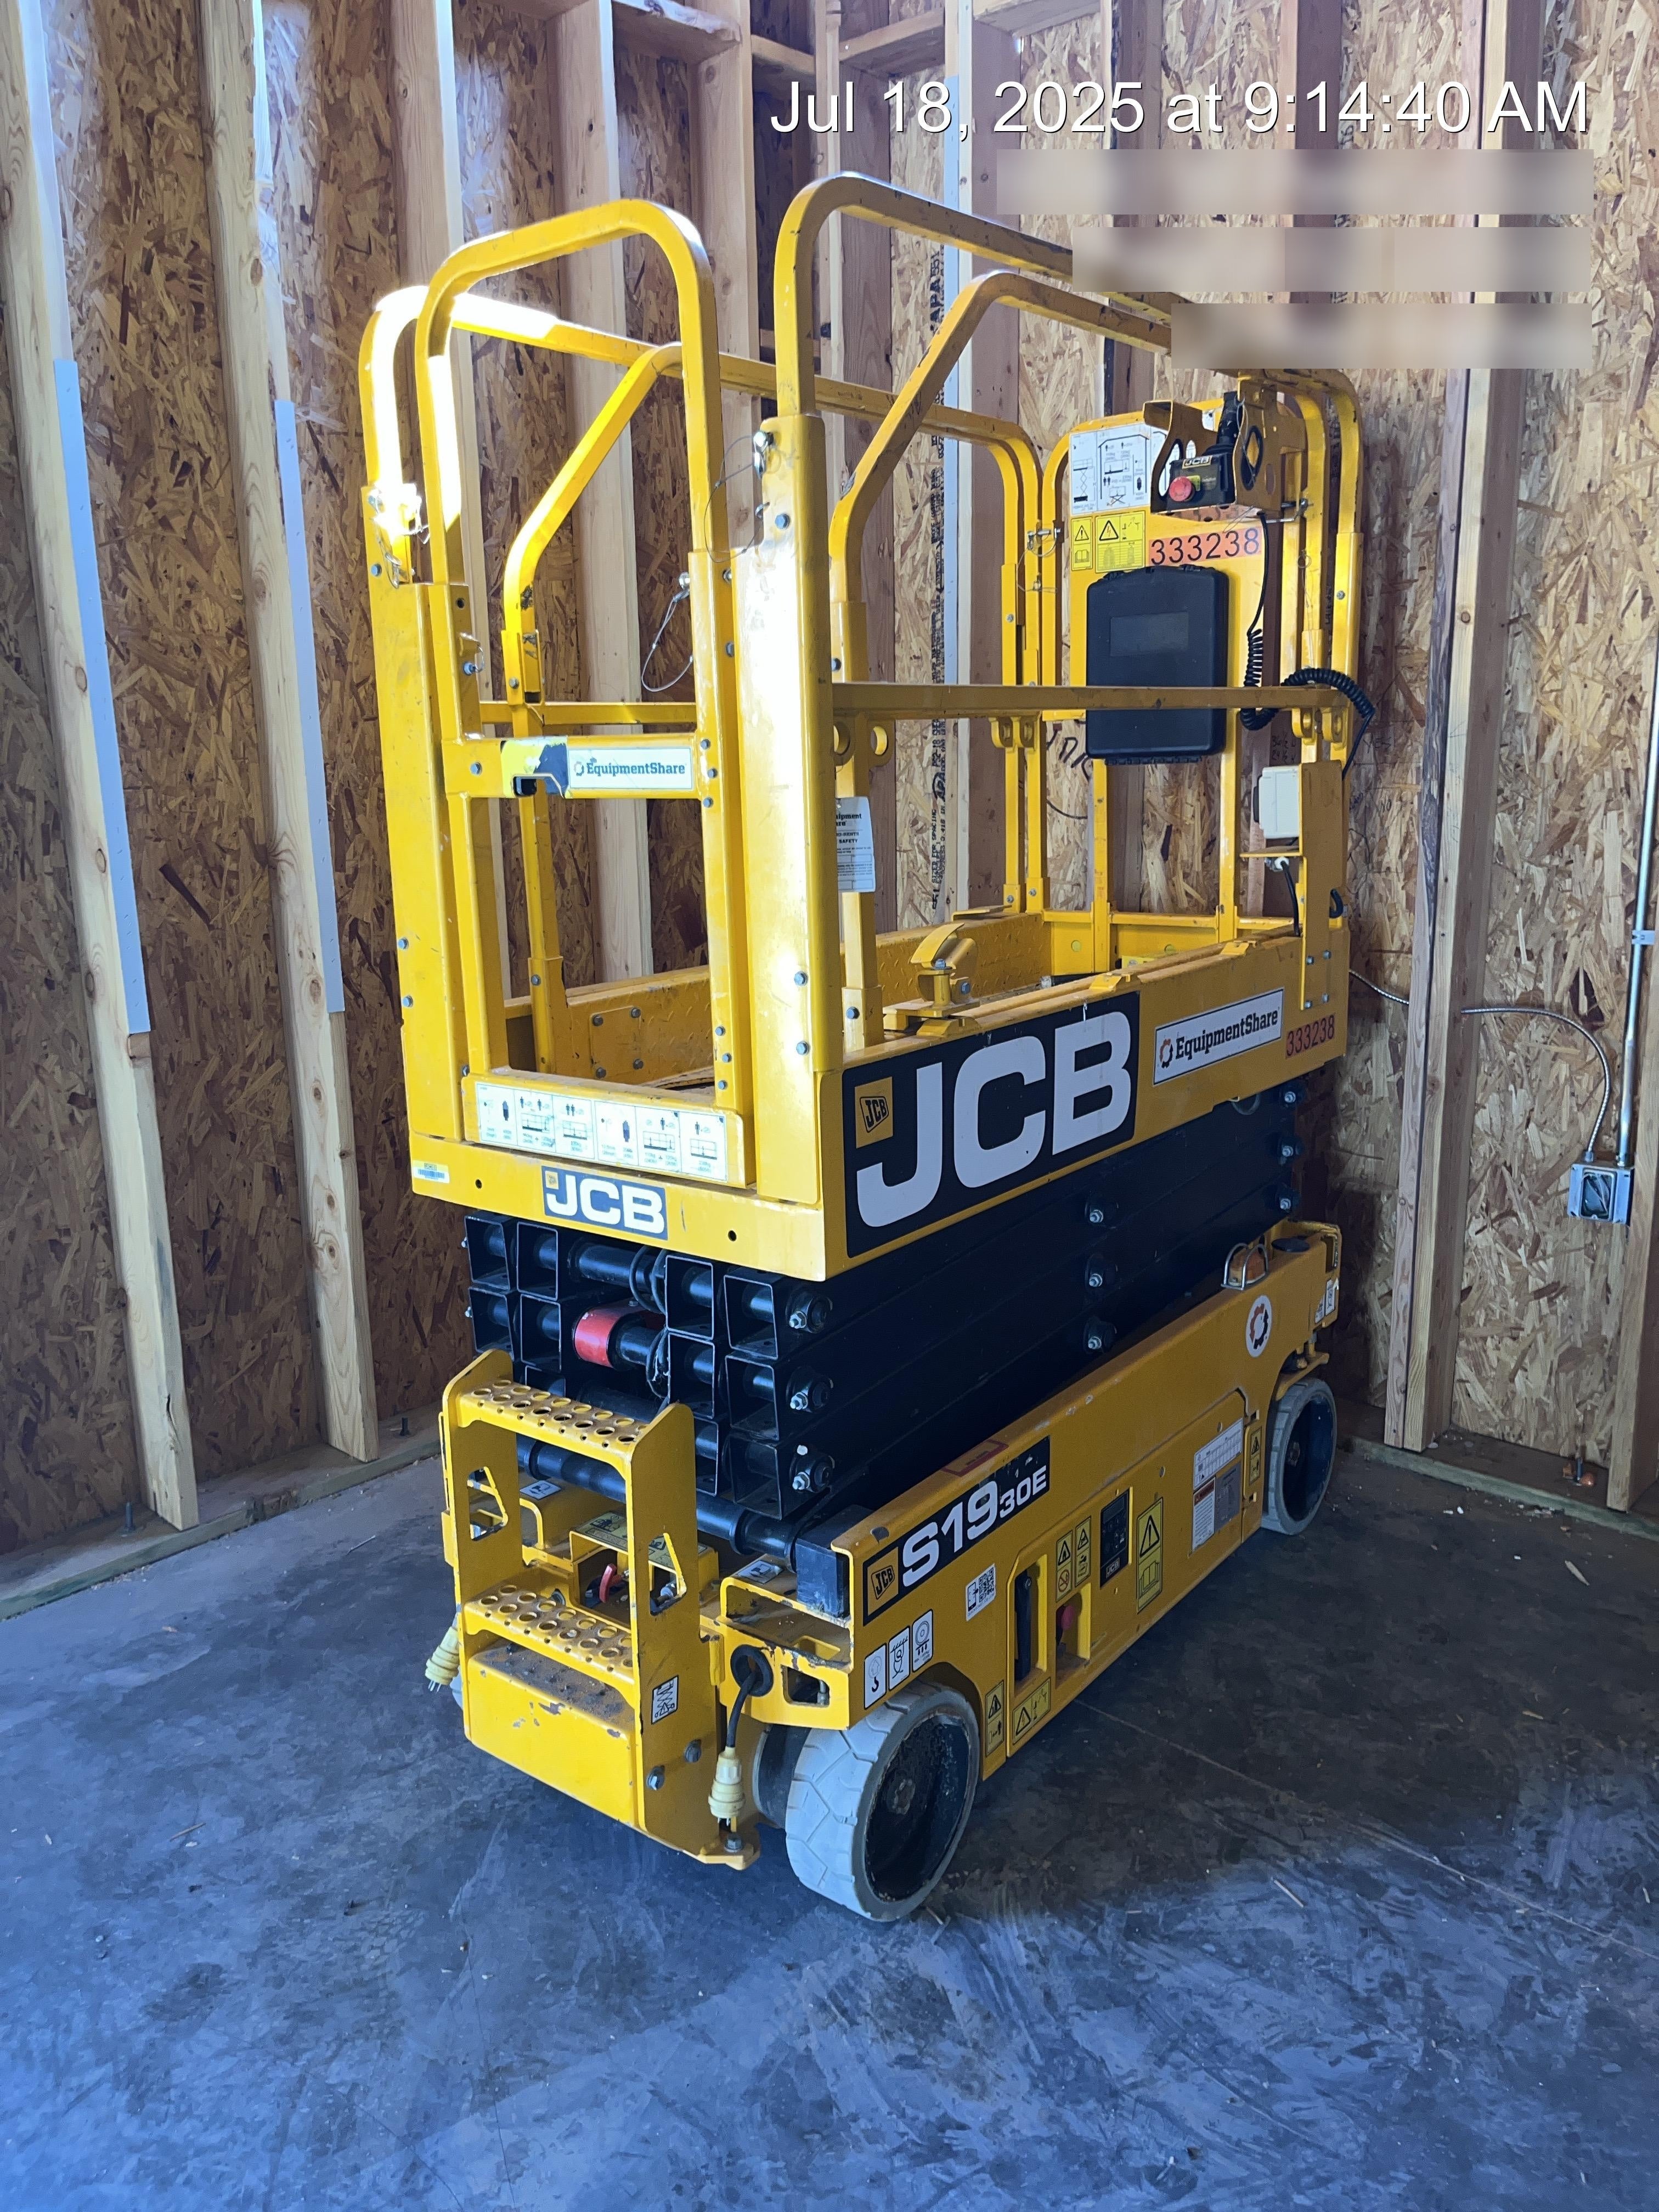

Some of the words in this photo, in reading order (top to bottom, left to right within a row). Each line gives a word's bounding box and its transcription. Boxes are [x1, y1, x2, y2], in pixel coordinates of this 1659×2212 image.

[1185, 456, 1210, 466] JCB
[1150, 527, 1260, 566] 333238
[586, 761, 685, 777] EquipmentShare
[1175, 1010, 1278, 1060] EquipmentShare
[1286, 1015, 1335, 1057] 333238
[857, 1011, 1131, 1227] JCB
[864, 1096, 888, 1128] JCB
[548, 1175, 665, 1234] JCB
[874, 1565, 895, 1593] JCB
[1106, 1560, 1119, 1576] JCB
